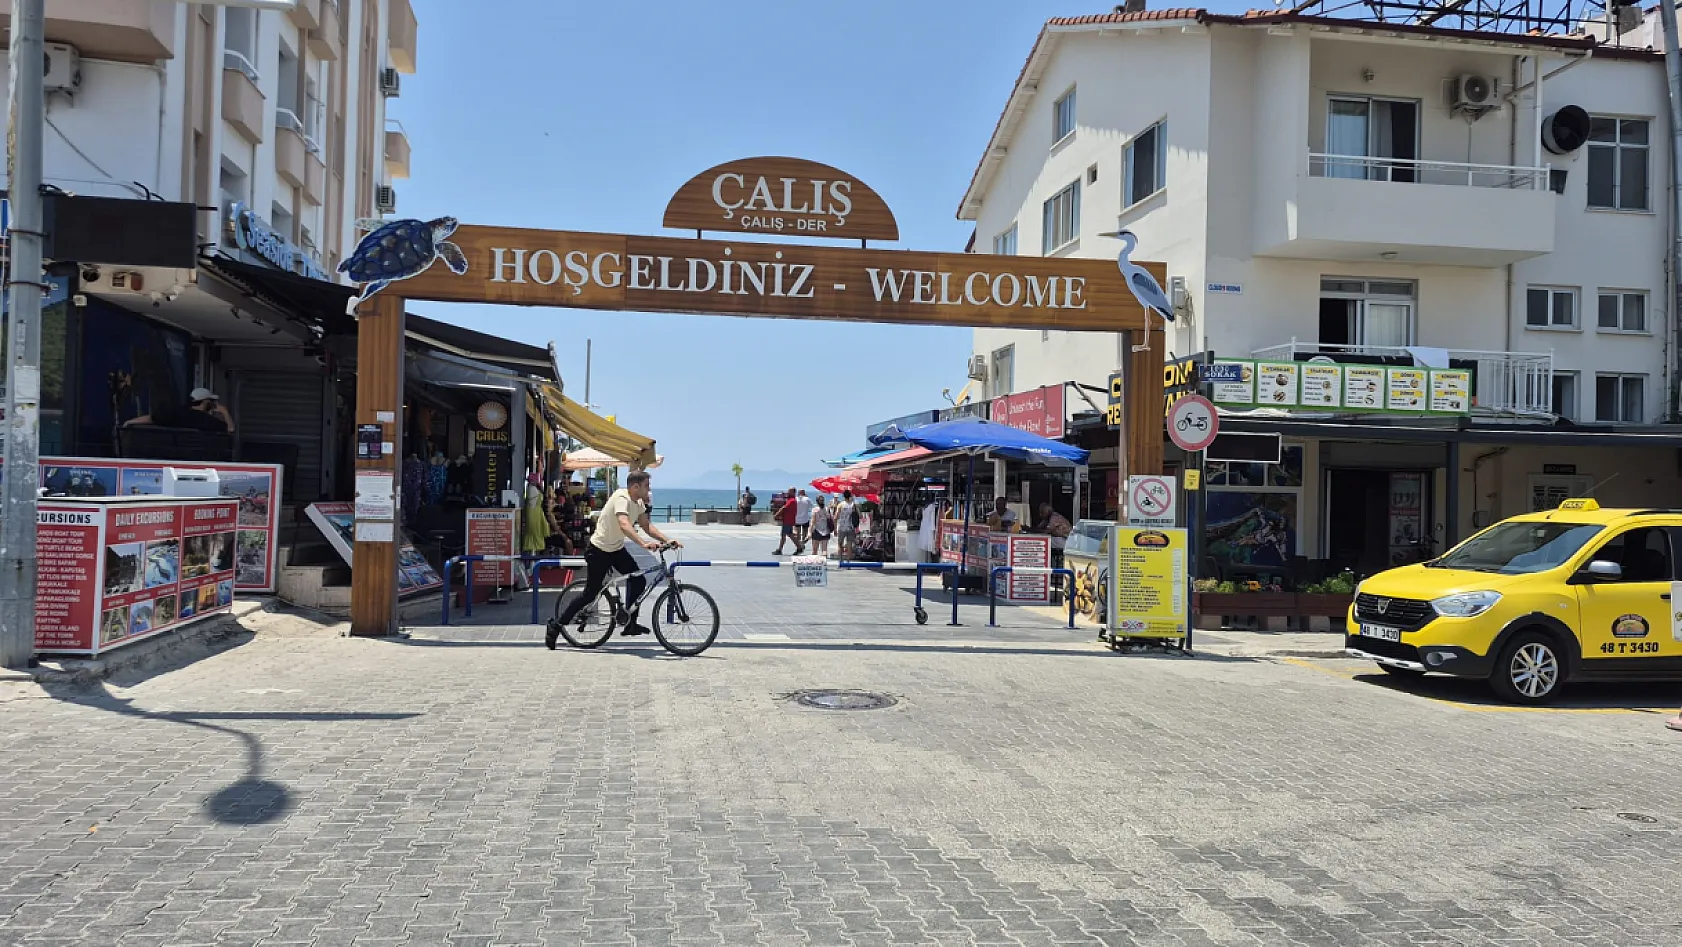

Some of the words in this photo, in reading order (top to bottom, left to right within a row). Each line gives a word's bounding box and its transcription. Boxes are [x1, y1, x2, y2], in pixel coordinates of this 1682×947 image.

[712, 173, 852, 226] ÇALIŞ
[741, 216, 784, 231] ÇALIŞ
[797, 218, 827, 231] DER
[490, 246, 815, 299] HOŞGELDİNİZ
[866, 268, 1086, 309] WELCOME
[37, 513, 91, 523] URSIONS
[116, 511, 135, 526] DAILY
[137, 510, 174, 525] EXCURSIONS
[194, 507, 215, 520] BOOKING
[217, 506, 230, 518] POINT
[1600, 642, 1614, 653] 48
[1618, 642, 1627, 653] T
[1630, 642, 1659, 653] 3430
